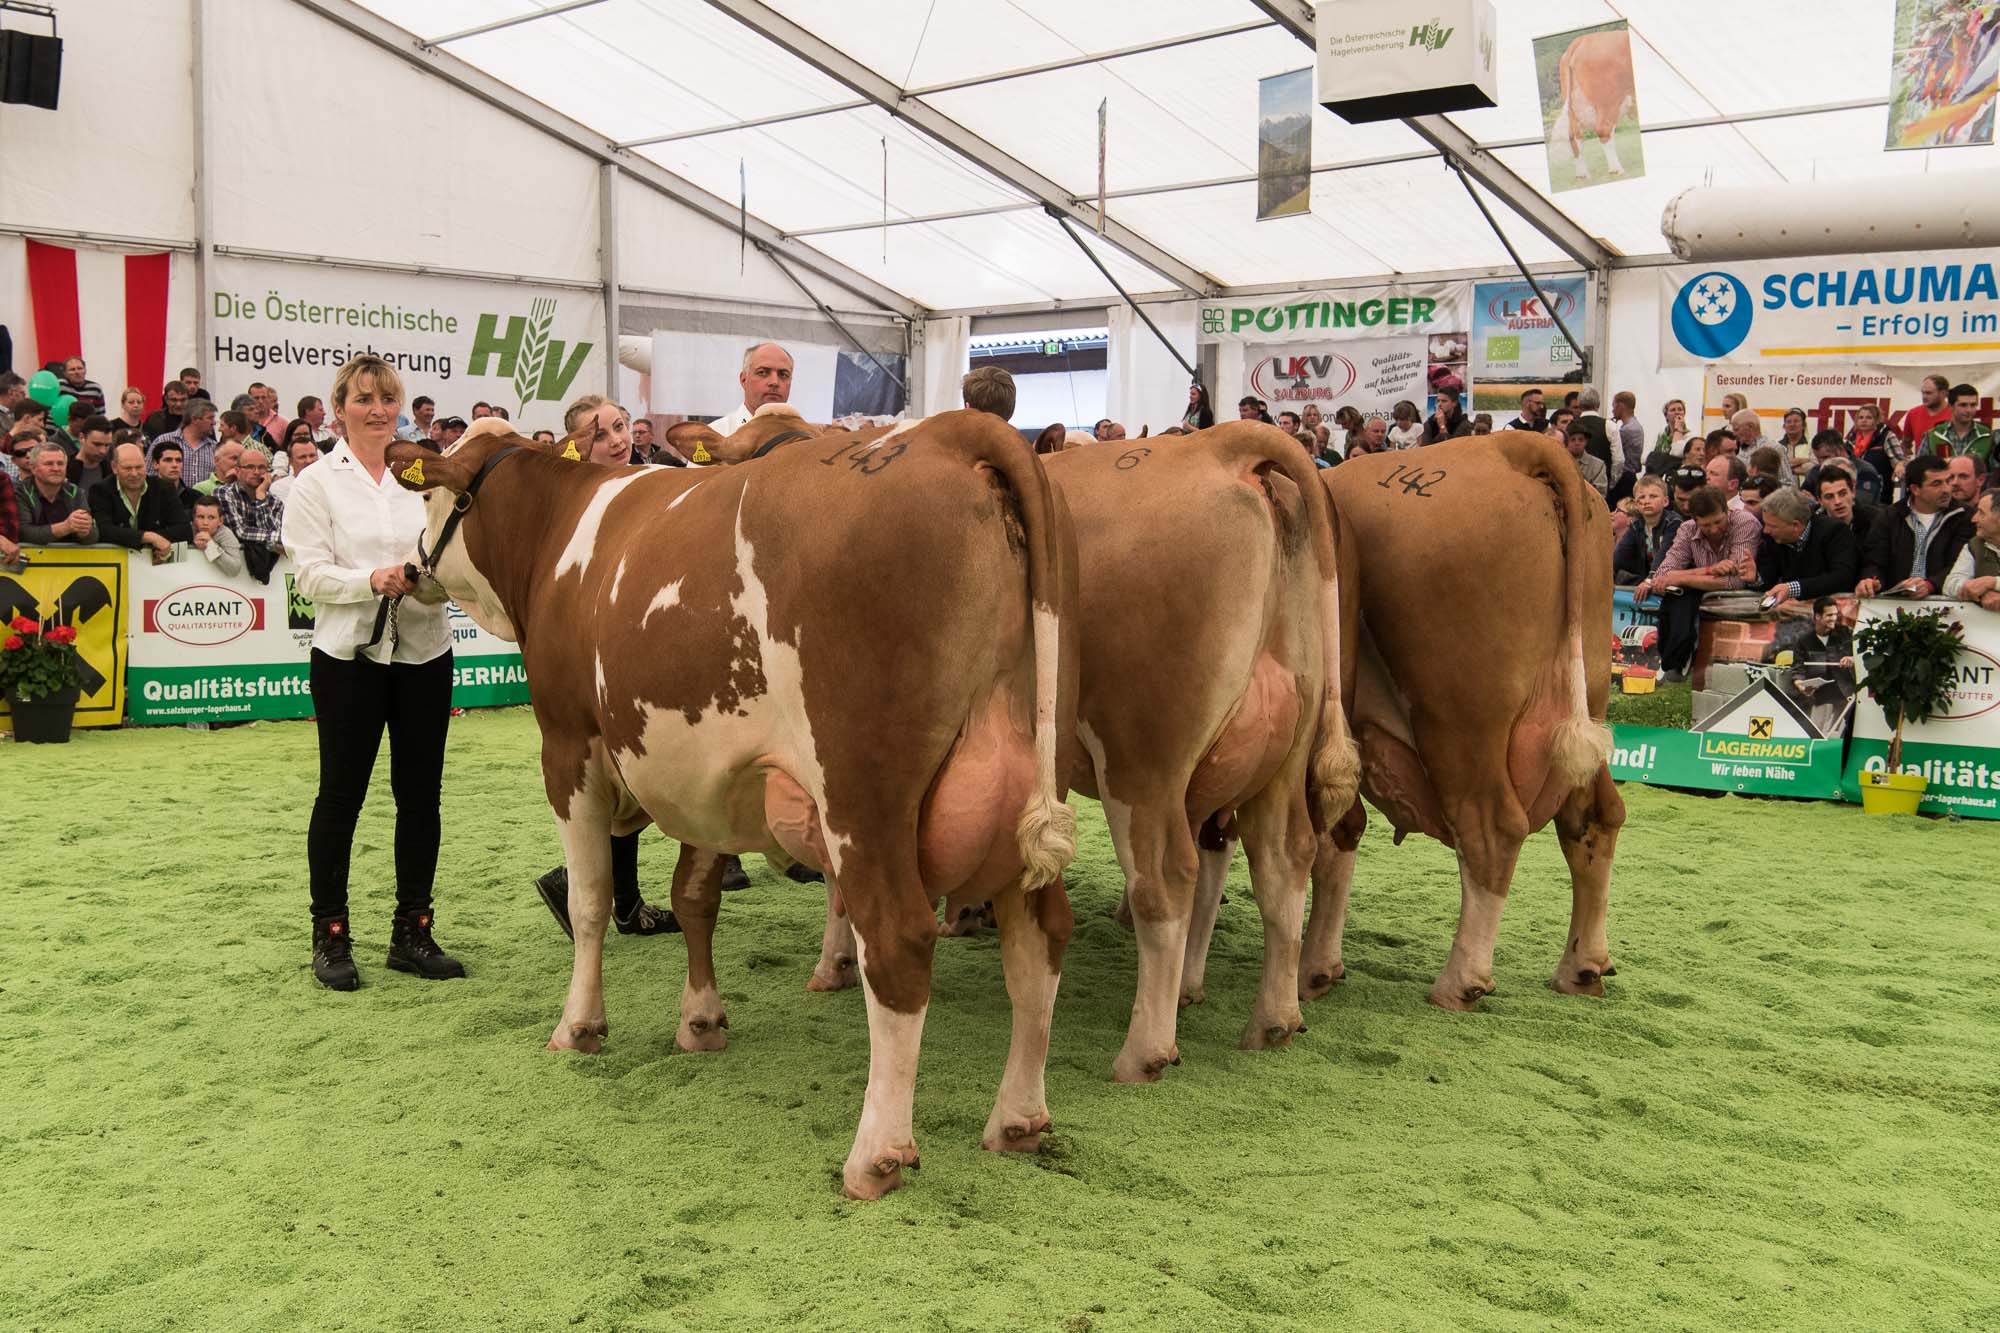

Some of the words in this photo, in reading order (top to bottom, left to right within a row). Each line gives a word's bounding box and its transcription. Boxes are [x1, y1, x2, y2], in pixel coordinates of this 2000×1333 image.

[1330, 36, 1343, 46] Die
[1330, 41, 1404, 57] Hagelversicherung
[1763, 263, 1999, 310] SCHAUMA
[214, 292, 256, 319] Die
[265, 290, 458, 334] Österreichische
[1231, 297, 1436, 333] PÖTTINGER
[1508, 319, 1555, 330] AUSTRIA
[1862, 313, 1949, 337] Erfolg
[1962, 311, 1997, 333] im
[467, 312, 594, 401] HV
[1273, 355, 1333, 379] LKV
[1716, 375, 1765, 386] Gesundes
[1768, 374, 1788, 385] Tier
[1796, 375, 1847, 386] Gesunder
[1850, 375, 1893, 386] Mensch
[1274, 387, 1334, 401] SALZBURG
[820, 440, 910, 475] 143
[1115, 447, 1152, 470] 6
[1377, 465, 1447, 498] 142
[168, 601, 243, 617] GARANT
[452, 628, 478, 643] qua
[1950, 666, 1994, 685] ANT
[143, 676, 312, 701] Qualitätsfutte
[1705, 739, 1806, 759] LAGERHAUS
[1711, 763, 1730, 776] Wir
[1732, 764, 1763, 778] leben
[1765, 766, 1796, 780] Nähe
